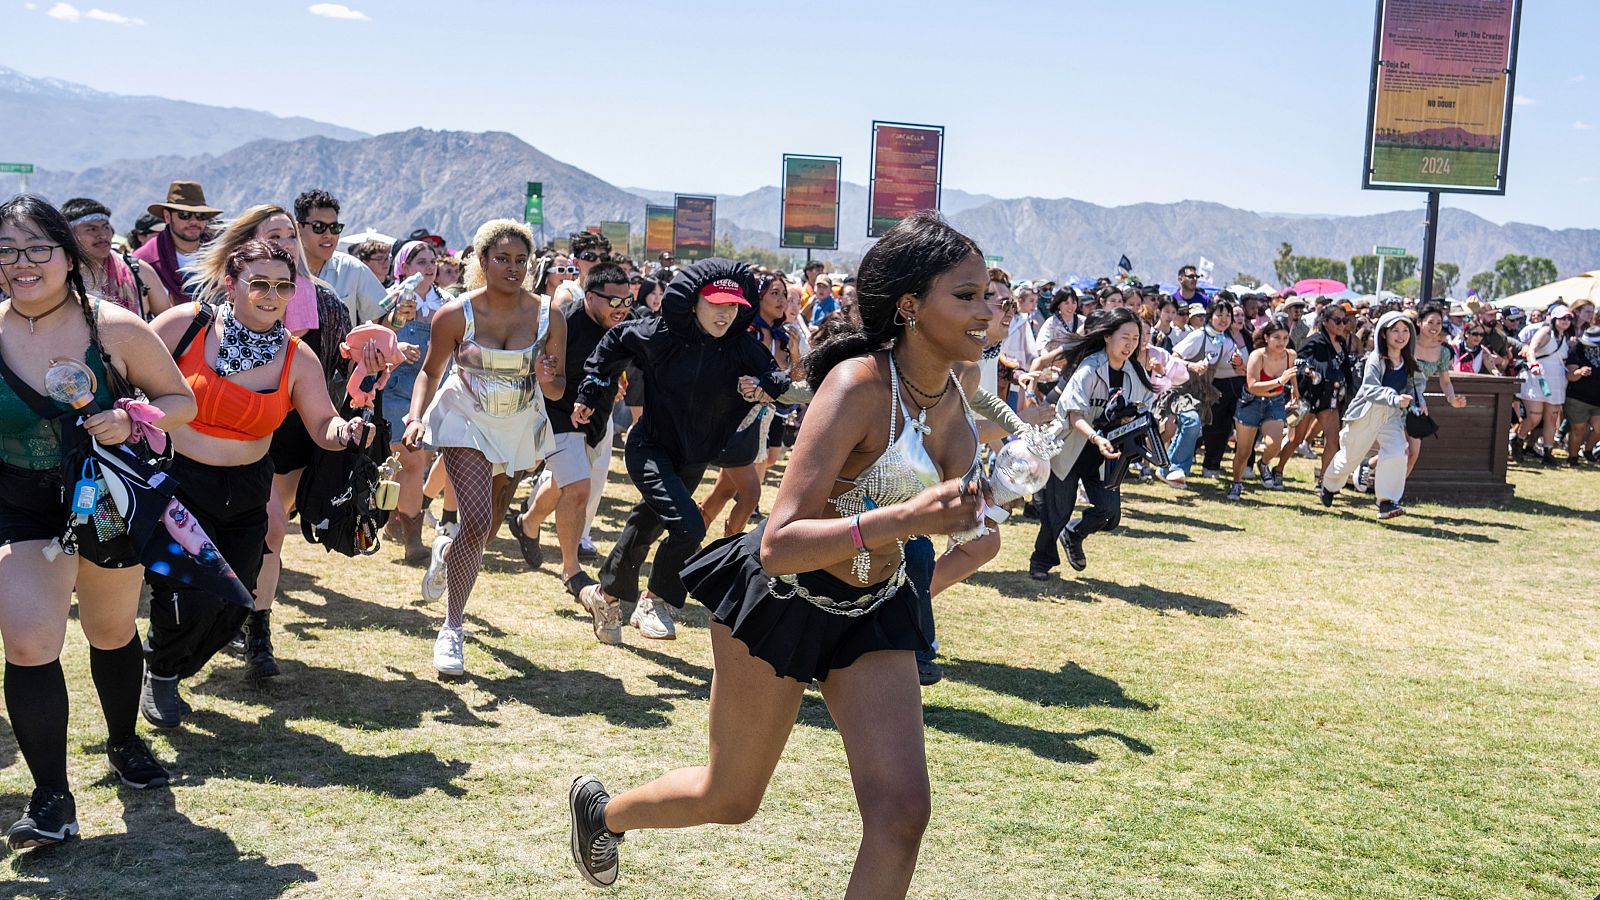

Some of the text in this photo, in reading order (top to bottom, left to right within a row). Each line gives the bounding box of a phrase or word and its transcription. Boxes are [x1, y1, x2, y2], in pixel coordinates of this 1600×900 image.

[1386, 61, 1410, 69] Doja Cat
[1427, 100, 1456, 109] NO DOUBT
[1421, 156, 1451, 175] 2024
